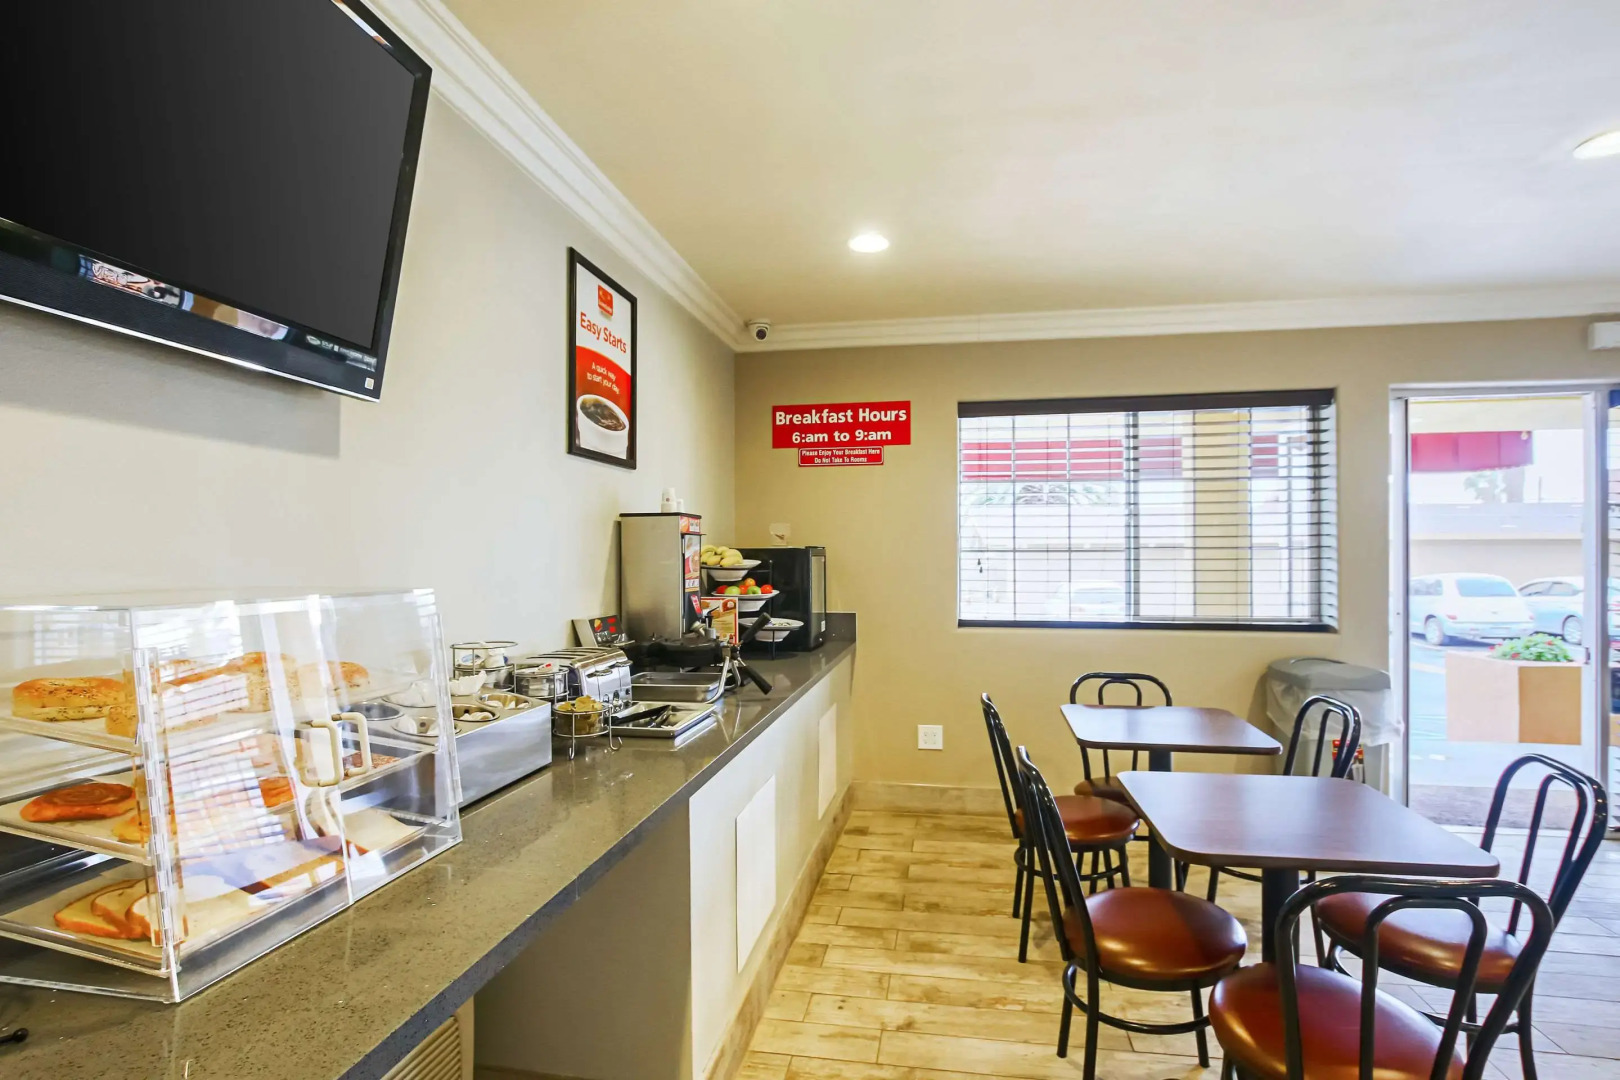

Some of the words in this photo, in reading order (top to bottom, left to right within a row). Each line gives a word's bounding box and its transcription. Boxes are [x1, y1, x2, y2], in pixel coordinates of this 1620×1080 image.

[580, 311, 602, 340] Easy
[603, 327, 627, 354] Starts
[586, 371, 592, 380] to
[591, 361, 596, 370] A
[608, 371, 616, 382] way
[775, 408, 853, 426] Breakfast
[858, 407, 907, 422] Hours
[792, 431, 829, 444] 6:am
[833, 430, 850, 442] to
[855, 429, 892, 442] 9:am
[818, 449, 832, 457] Enjoy
